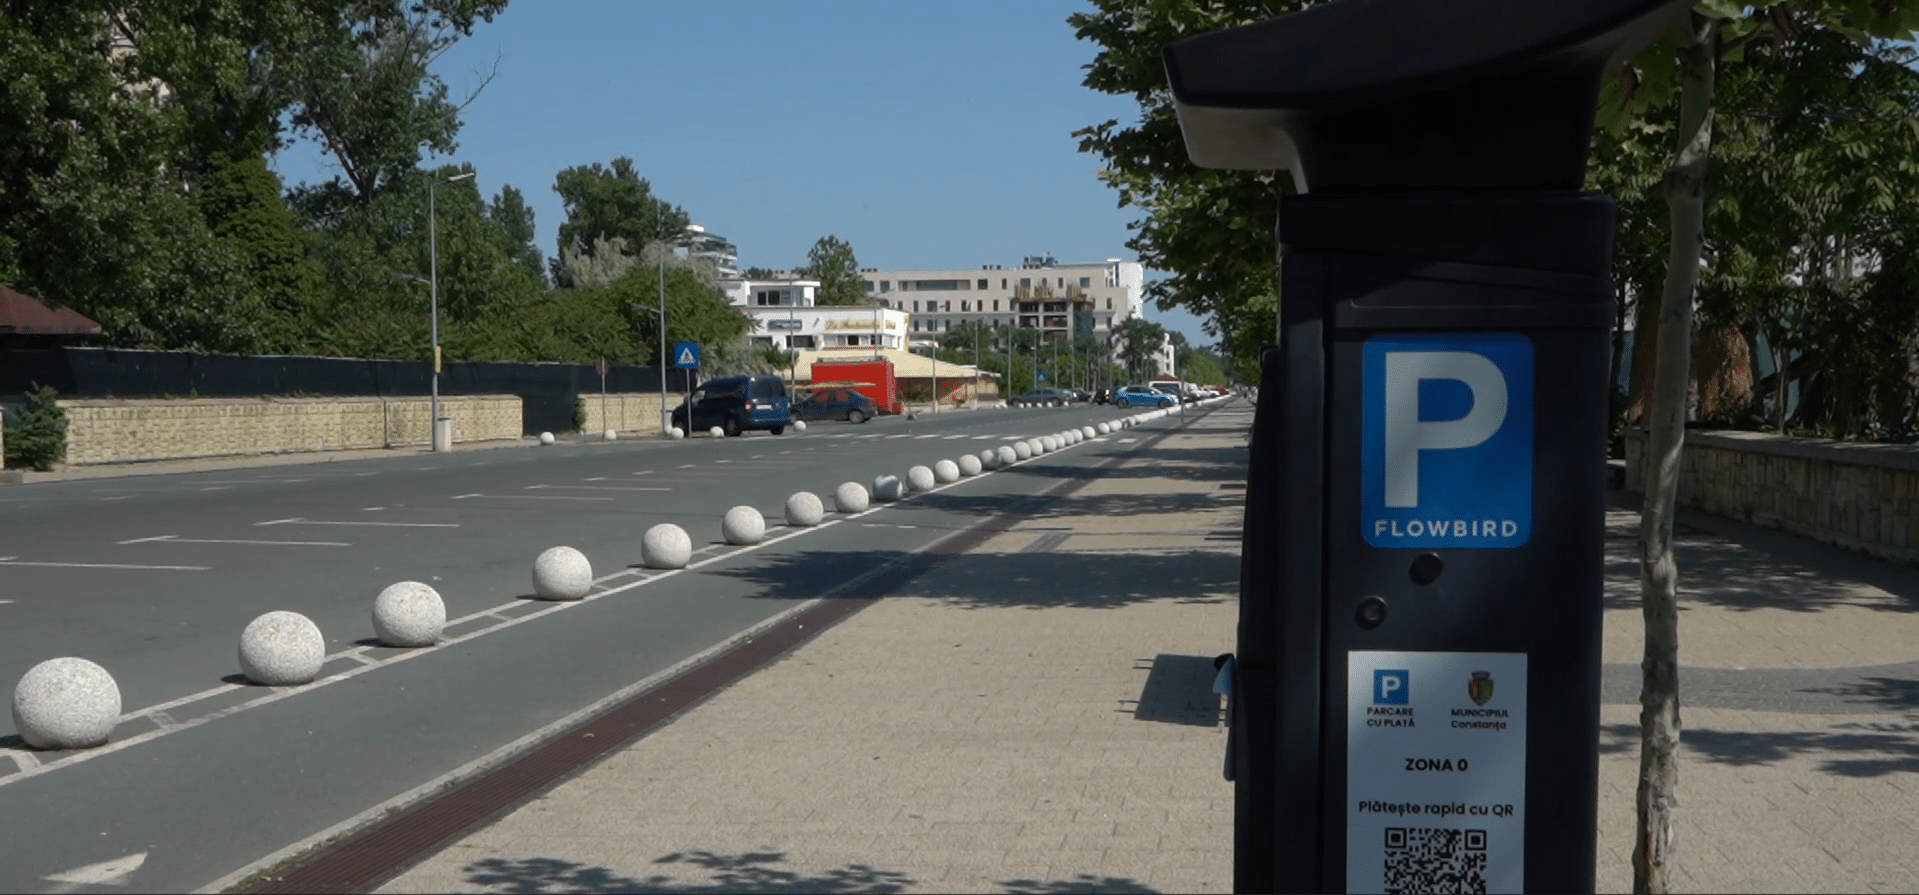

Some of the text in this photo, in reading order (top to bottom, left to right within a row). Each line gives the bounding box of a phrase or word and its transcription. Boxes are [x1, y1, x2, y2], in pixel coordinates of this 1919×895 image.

[1374, 519, 1518, 538] FLOWBIRD
[1366, 706, 1414, 717] PARCARE
[1450, 708, 1510, 718] MUNICIPIUL
[1366, 718, 1382, 728] CU
[1404, 757, 1454, 772] ZONA
[1424, 801, 1466, 818] rapid
[1469, 804, 1488, 816] cu
[1492, 803, 1515, 818] QR
